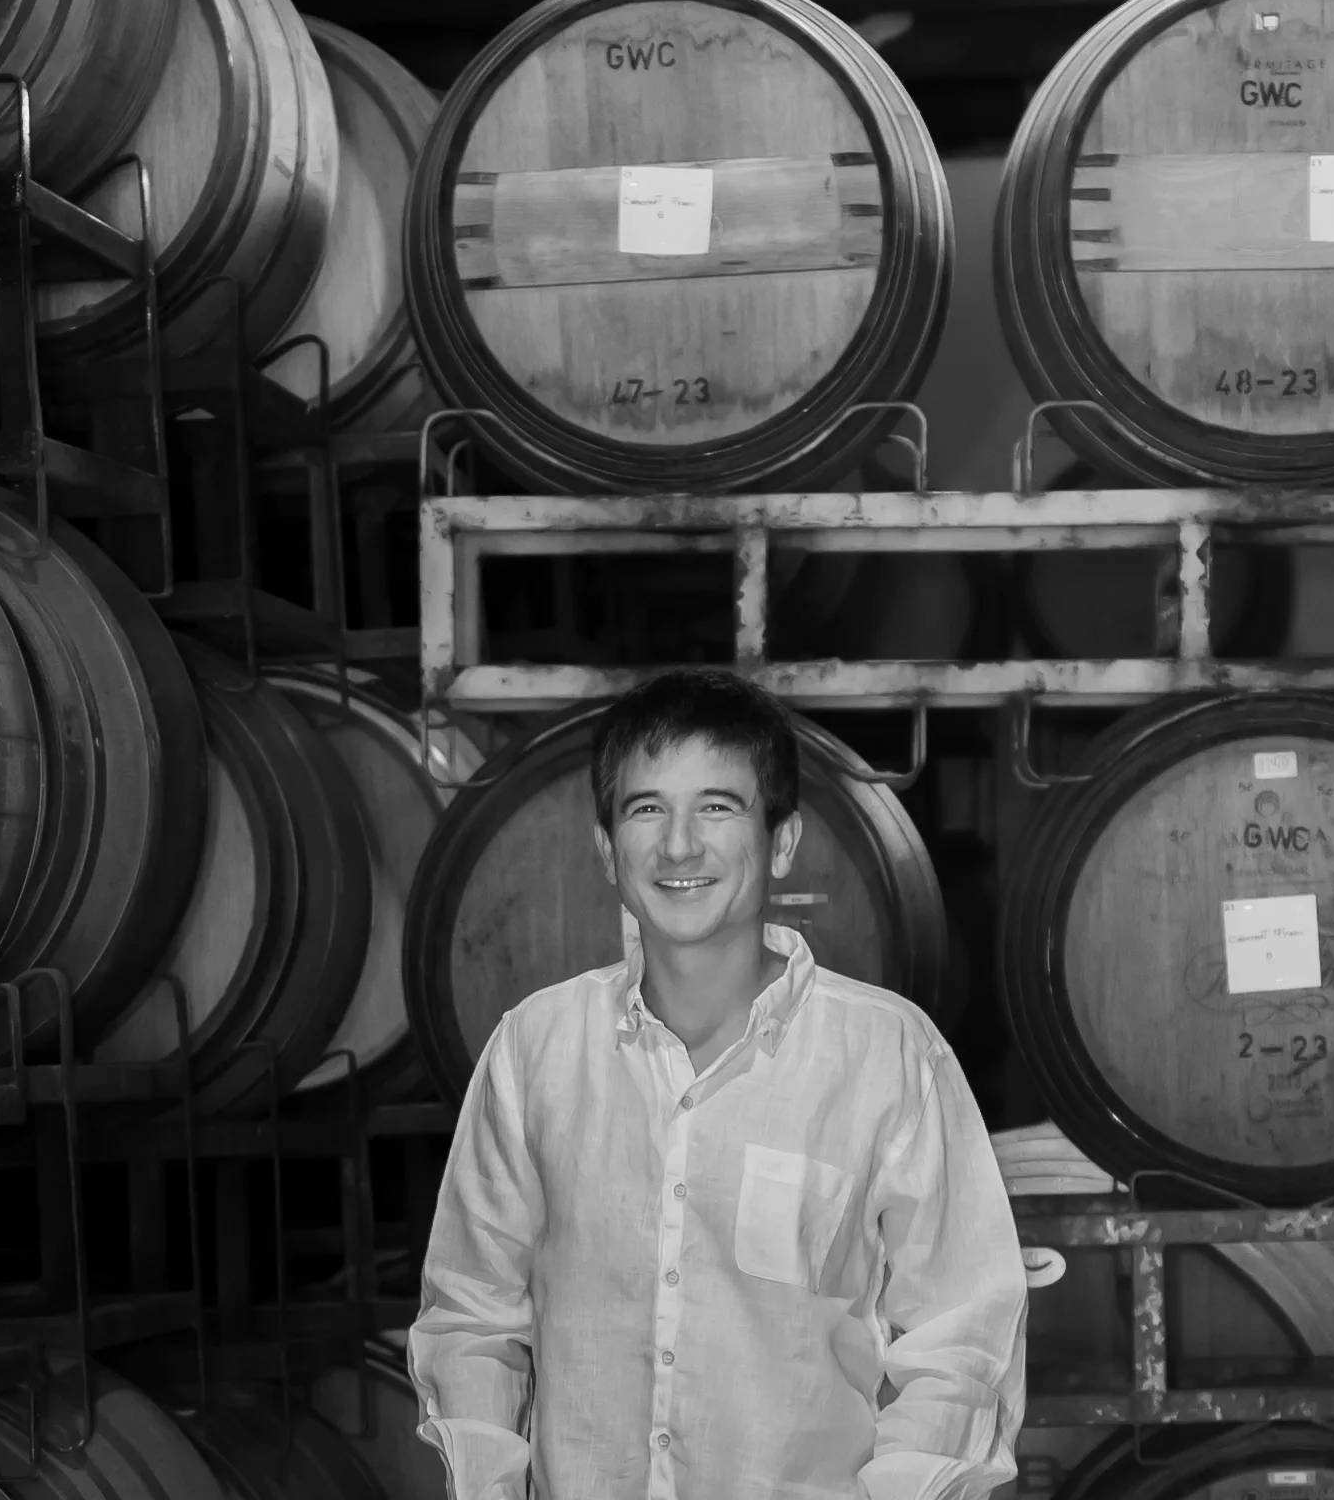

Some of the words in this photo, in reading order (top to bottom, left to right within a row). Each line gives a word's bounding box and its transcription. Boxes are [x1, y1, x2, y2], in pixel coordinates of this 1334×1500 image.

[606, 41, 676, 70] GWC
[1240, 80, 1302, 107] GWC
[611, 377, 710, 405] 47-23
[1215, 368, 1317, 396] 48-23
[1244, 823, 1310, 852] GWC
[1238, 1032, 1327, 1062] 2-23
